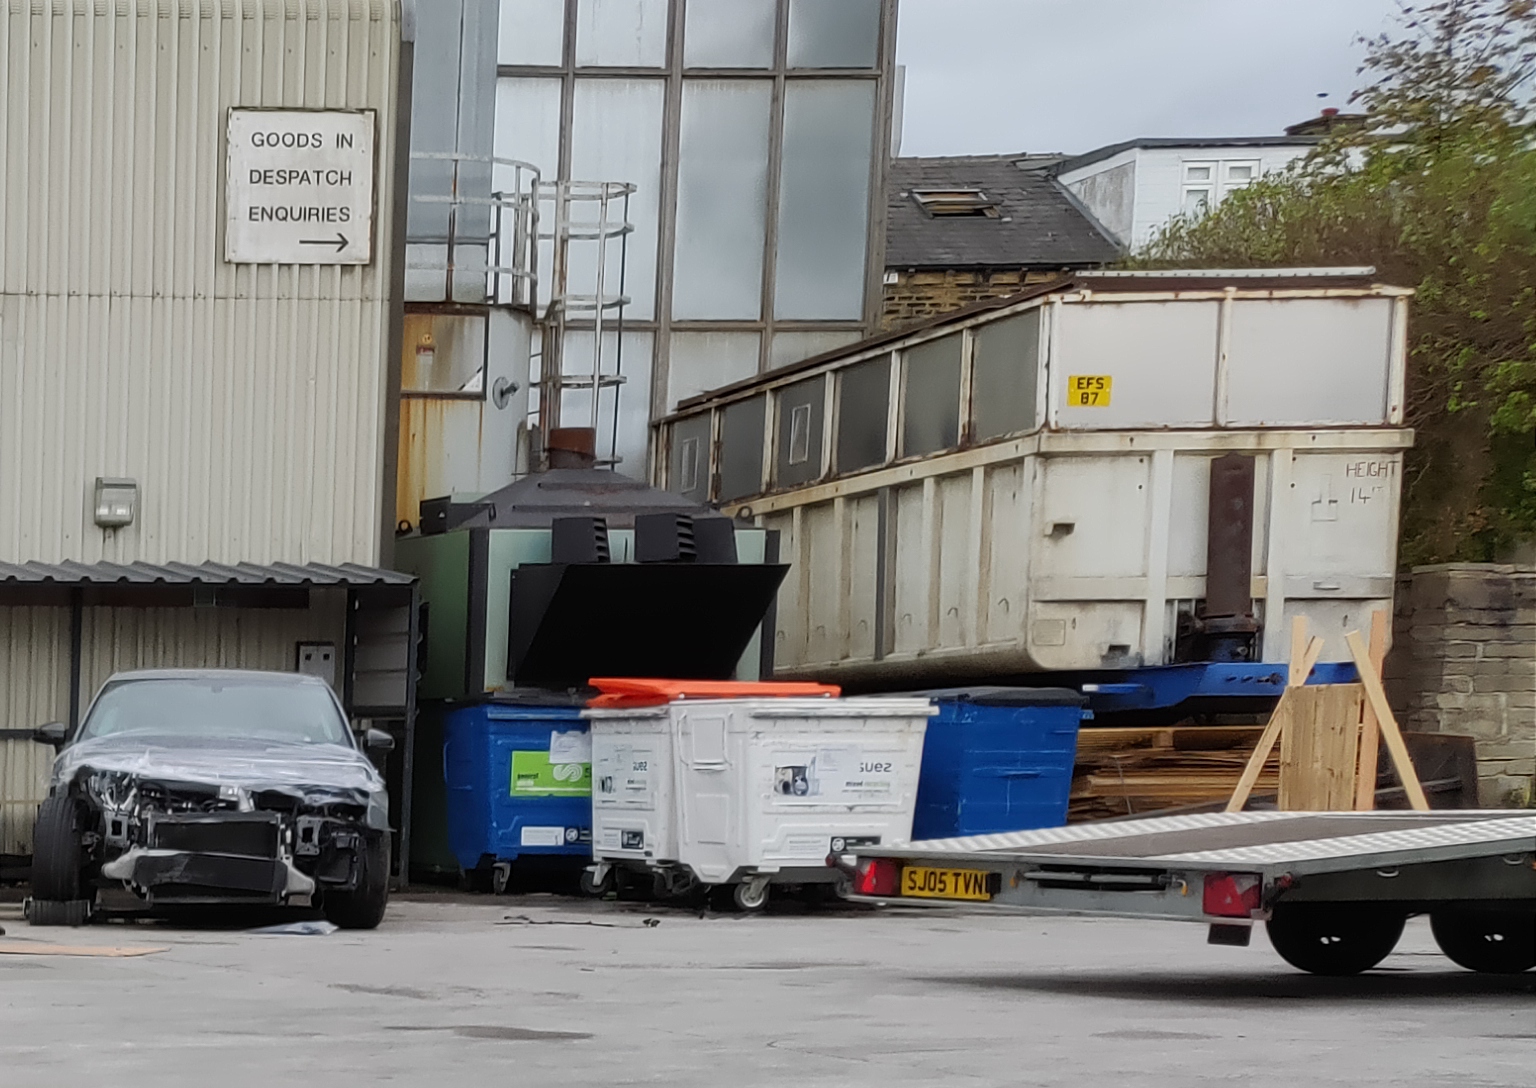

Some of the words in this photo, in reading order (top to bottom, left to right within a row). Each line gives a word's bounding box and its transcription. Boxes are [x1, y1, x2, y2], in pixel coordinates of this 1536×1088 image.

[251, 132, 323, 149] GOODS
[336, 133, 353, 149] IN
[249, 169, 352, 186] DESPATCH
[249, 206, 350, 222] ENQUIRIES
[1077, 377, 1104, 390] EFS
[1081, 392, 1099, 405] 87
[1346, 460, 1399, 477] HEIGHT
[908, 870, 947, 893] SJ05
